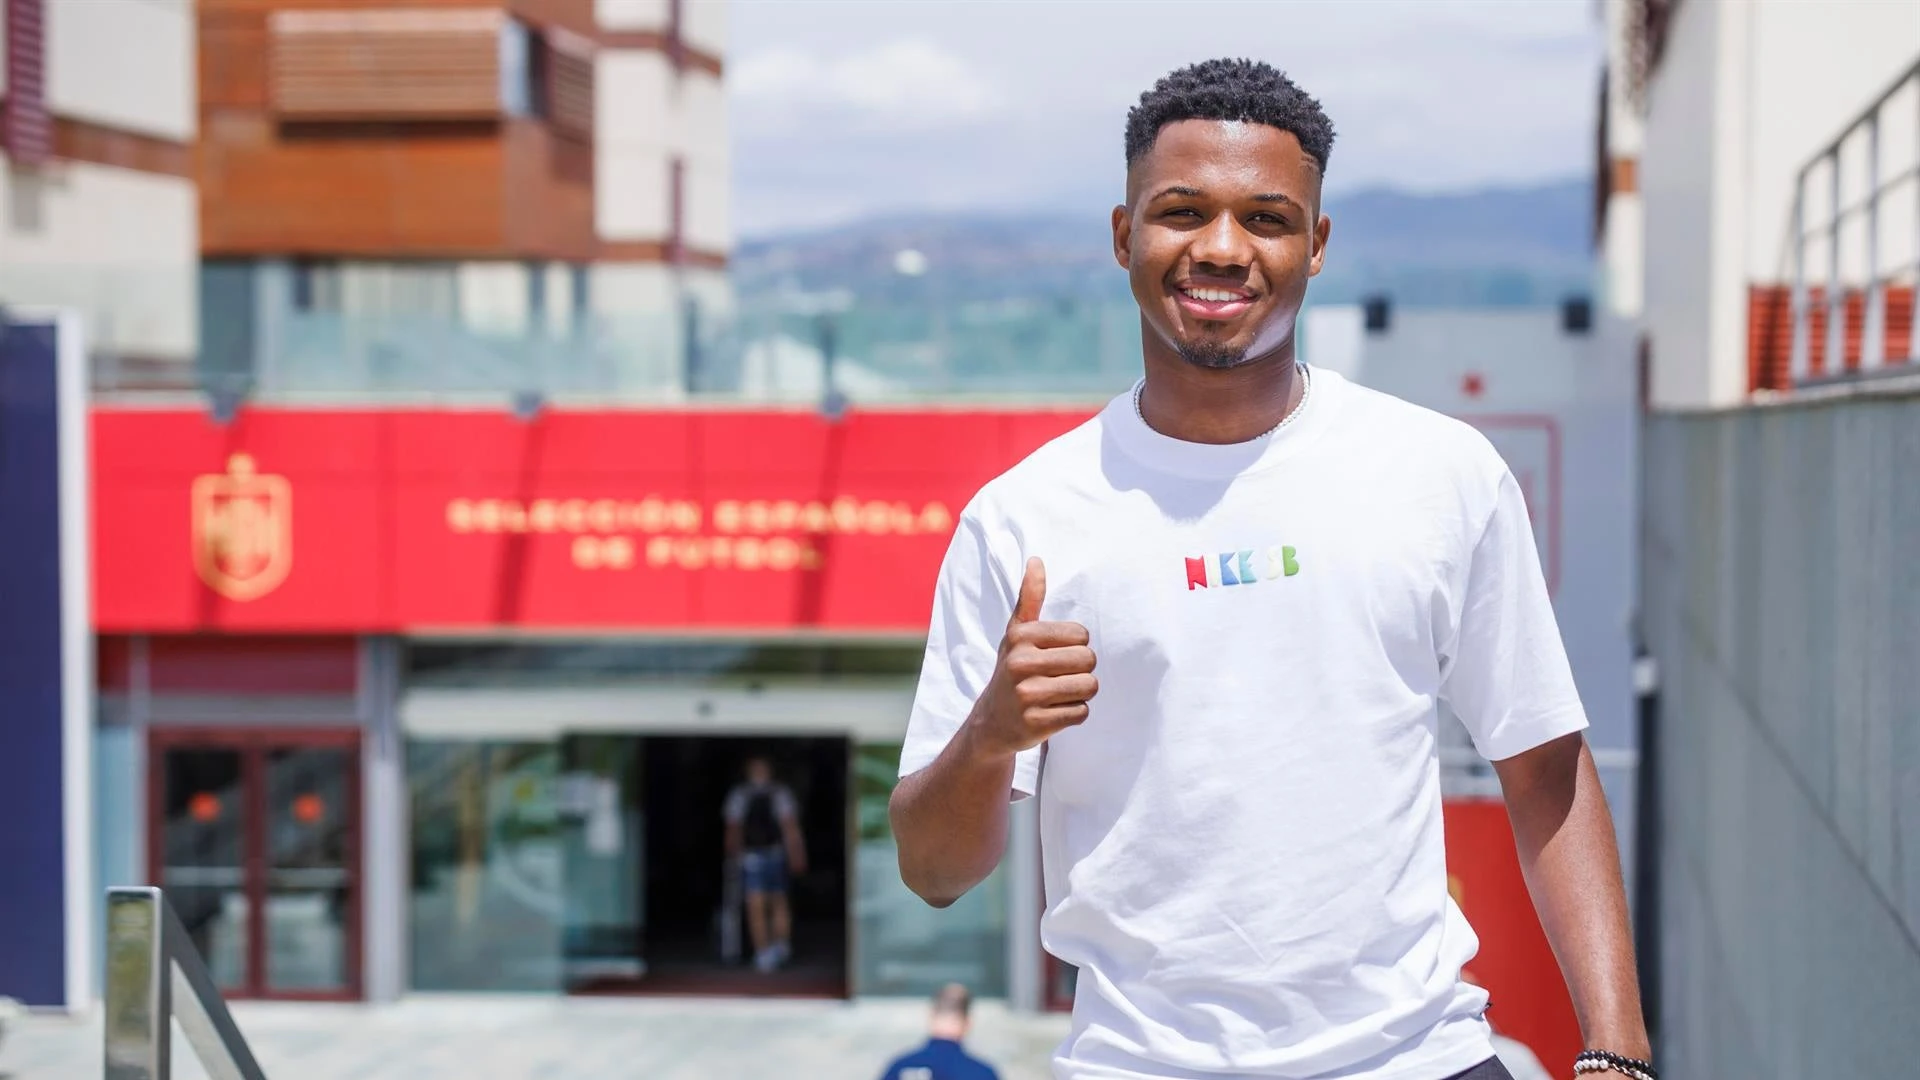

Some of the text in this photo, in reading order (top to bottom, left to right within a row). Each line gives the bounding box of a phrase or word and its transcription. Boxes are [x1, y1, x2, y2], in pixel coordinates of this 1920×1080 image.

[573, 536, 633, 570] DE
[1185, 545, 1300, 590] NIKE SB
